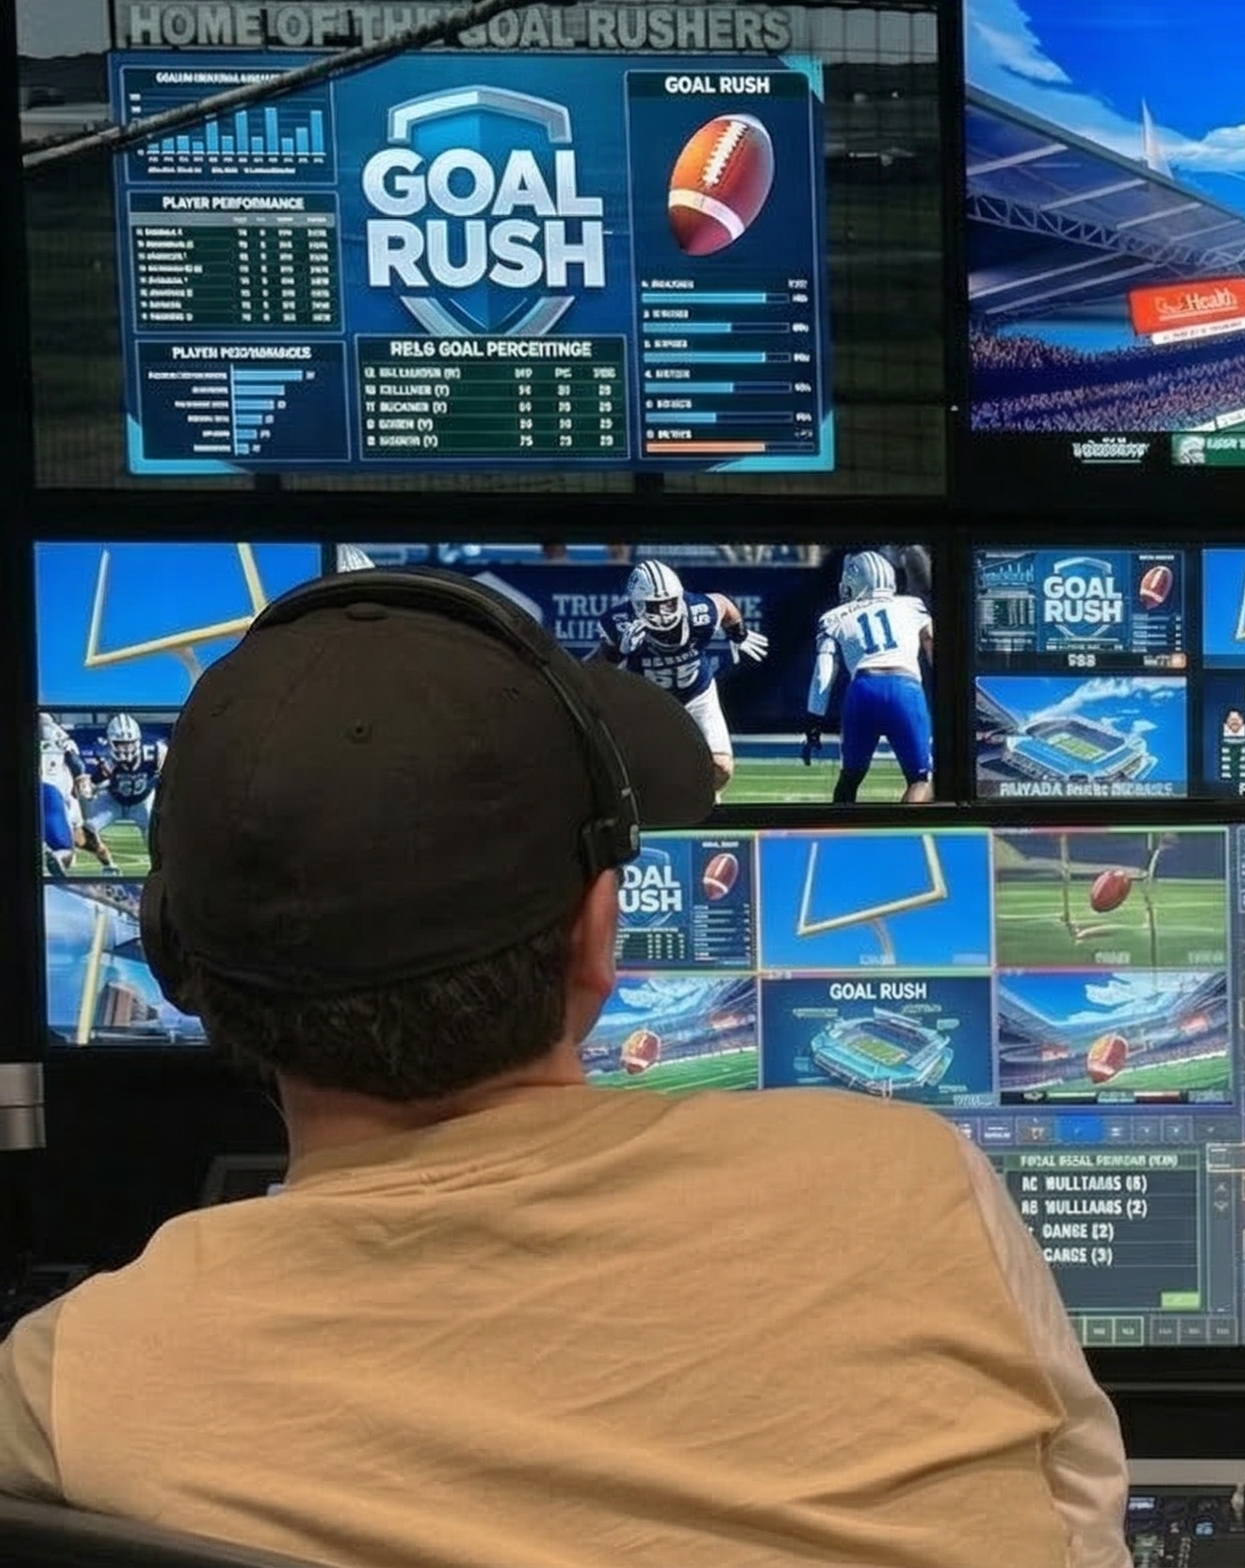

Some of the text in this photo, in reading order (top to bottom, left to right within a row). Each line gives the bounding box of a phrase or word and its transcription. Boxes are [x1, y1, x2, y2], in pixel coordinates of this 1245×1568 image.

[130, 5, 262, 46] HOME
[276, 5, 335, 46] OF
[588, 7, 792, 49] RUSHERS
[665, 76, 770, 93] GOAL RUSH
[363, 148, 604, 217] GOAL
[162, 196, 209, 210] PLAYER
[367, 219, 606, 288] RUSH
[439, 341, 484, 357] GOAL
[1043, 576, 1122, 600] GOAL
[1044, 600, 1123, 623] RUSH
[857, 609, 898, 654] 11
[618, 889, 683, 913] USH
[829, 982, 927, 1000] GOAL RUSH
